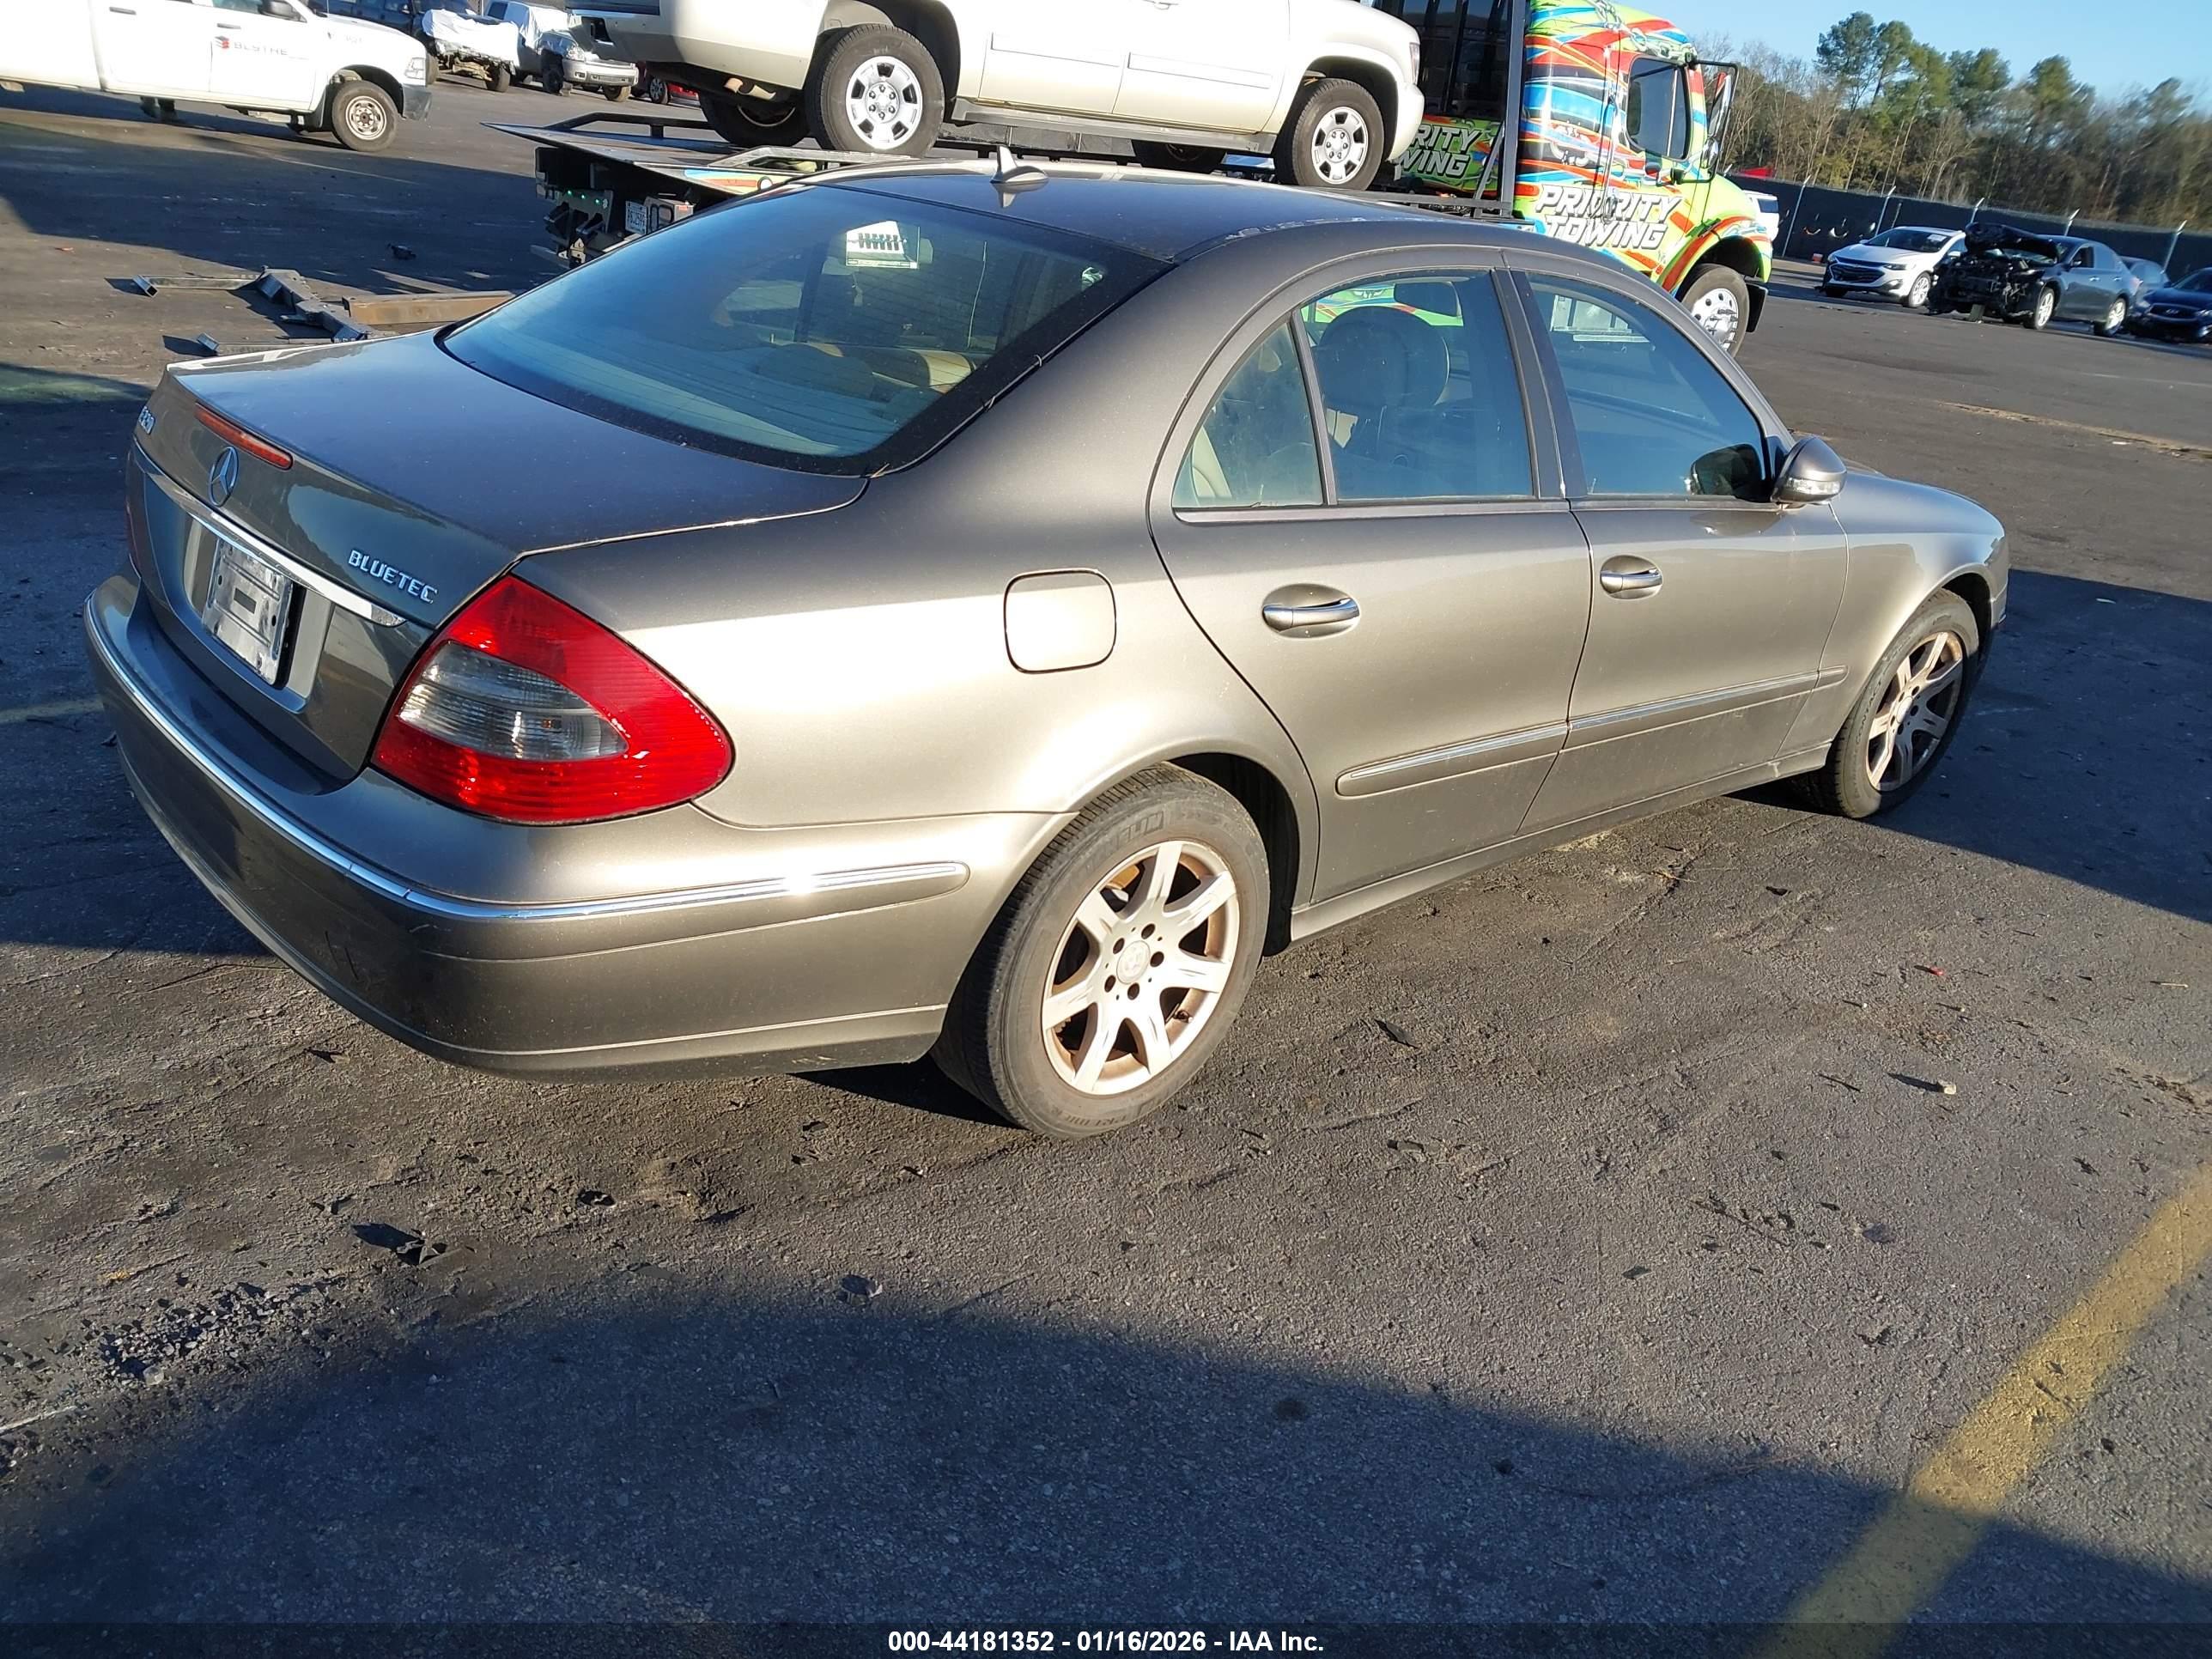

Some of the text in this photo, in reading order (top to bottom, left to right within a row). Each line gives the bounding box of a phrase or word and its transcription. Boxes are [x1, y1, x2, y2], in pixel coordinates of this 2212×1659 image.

[1535, 185, 1683, 224] PRIORITY
[1545, 215, 1668, 250] TOWING
[348, 549, 439, 604] BLUETEC
